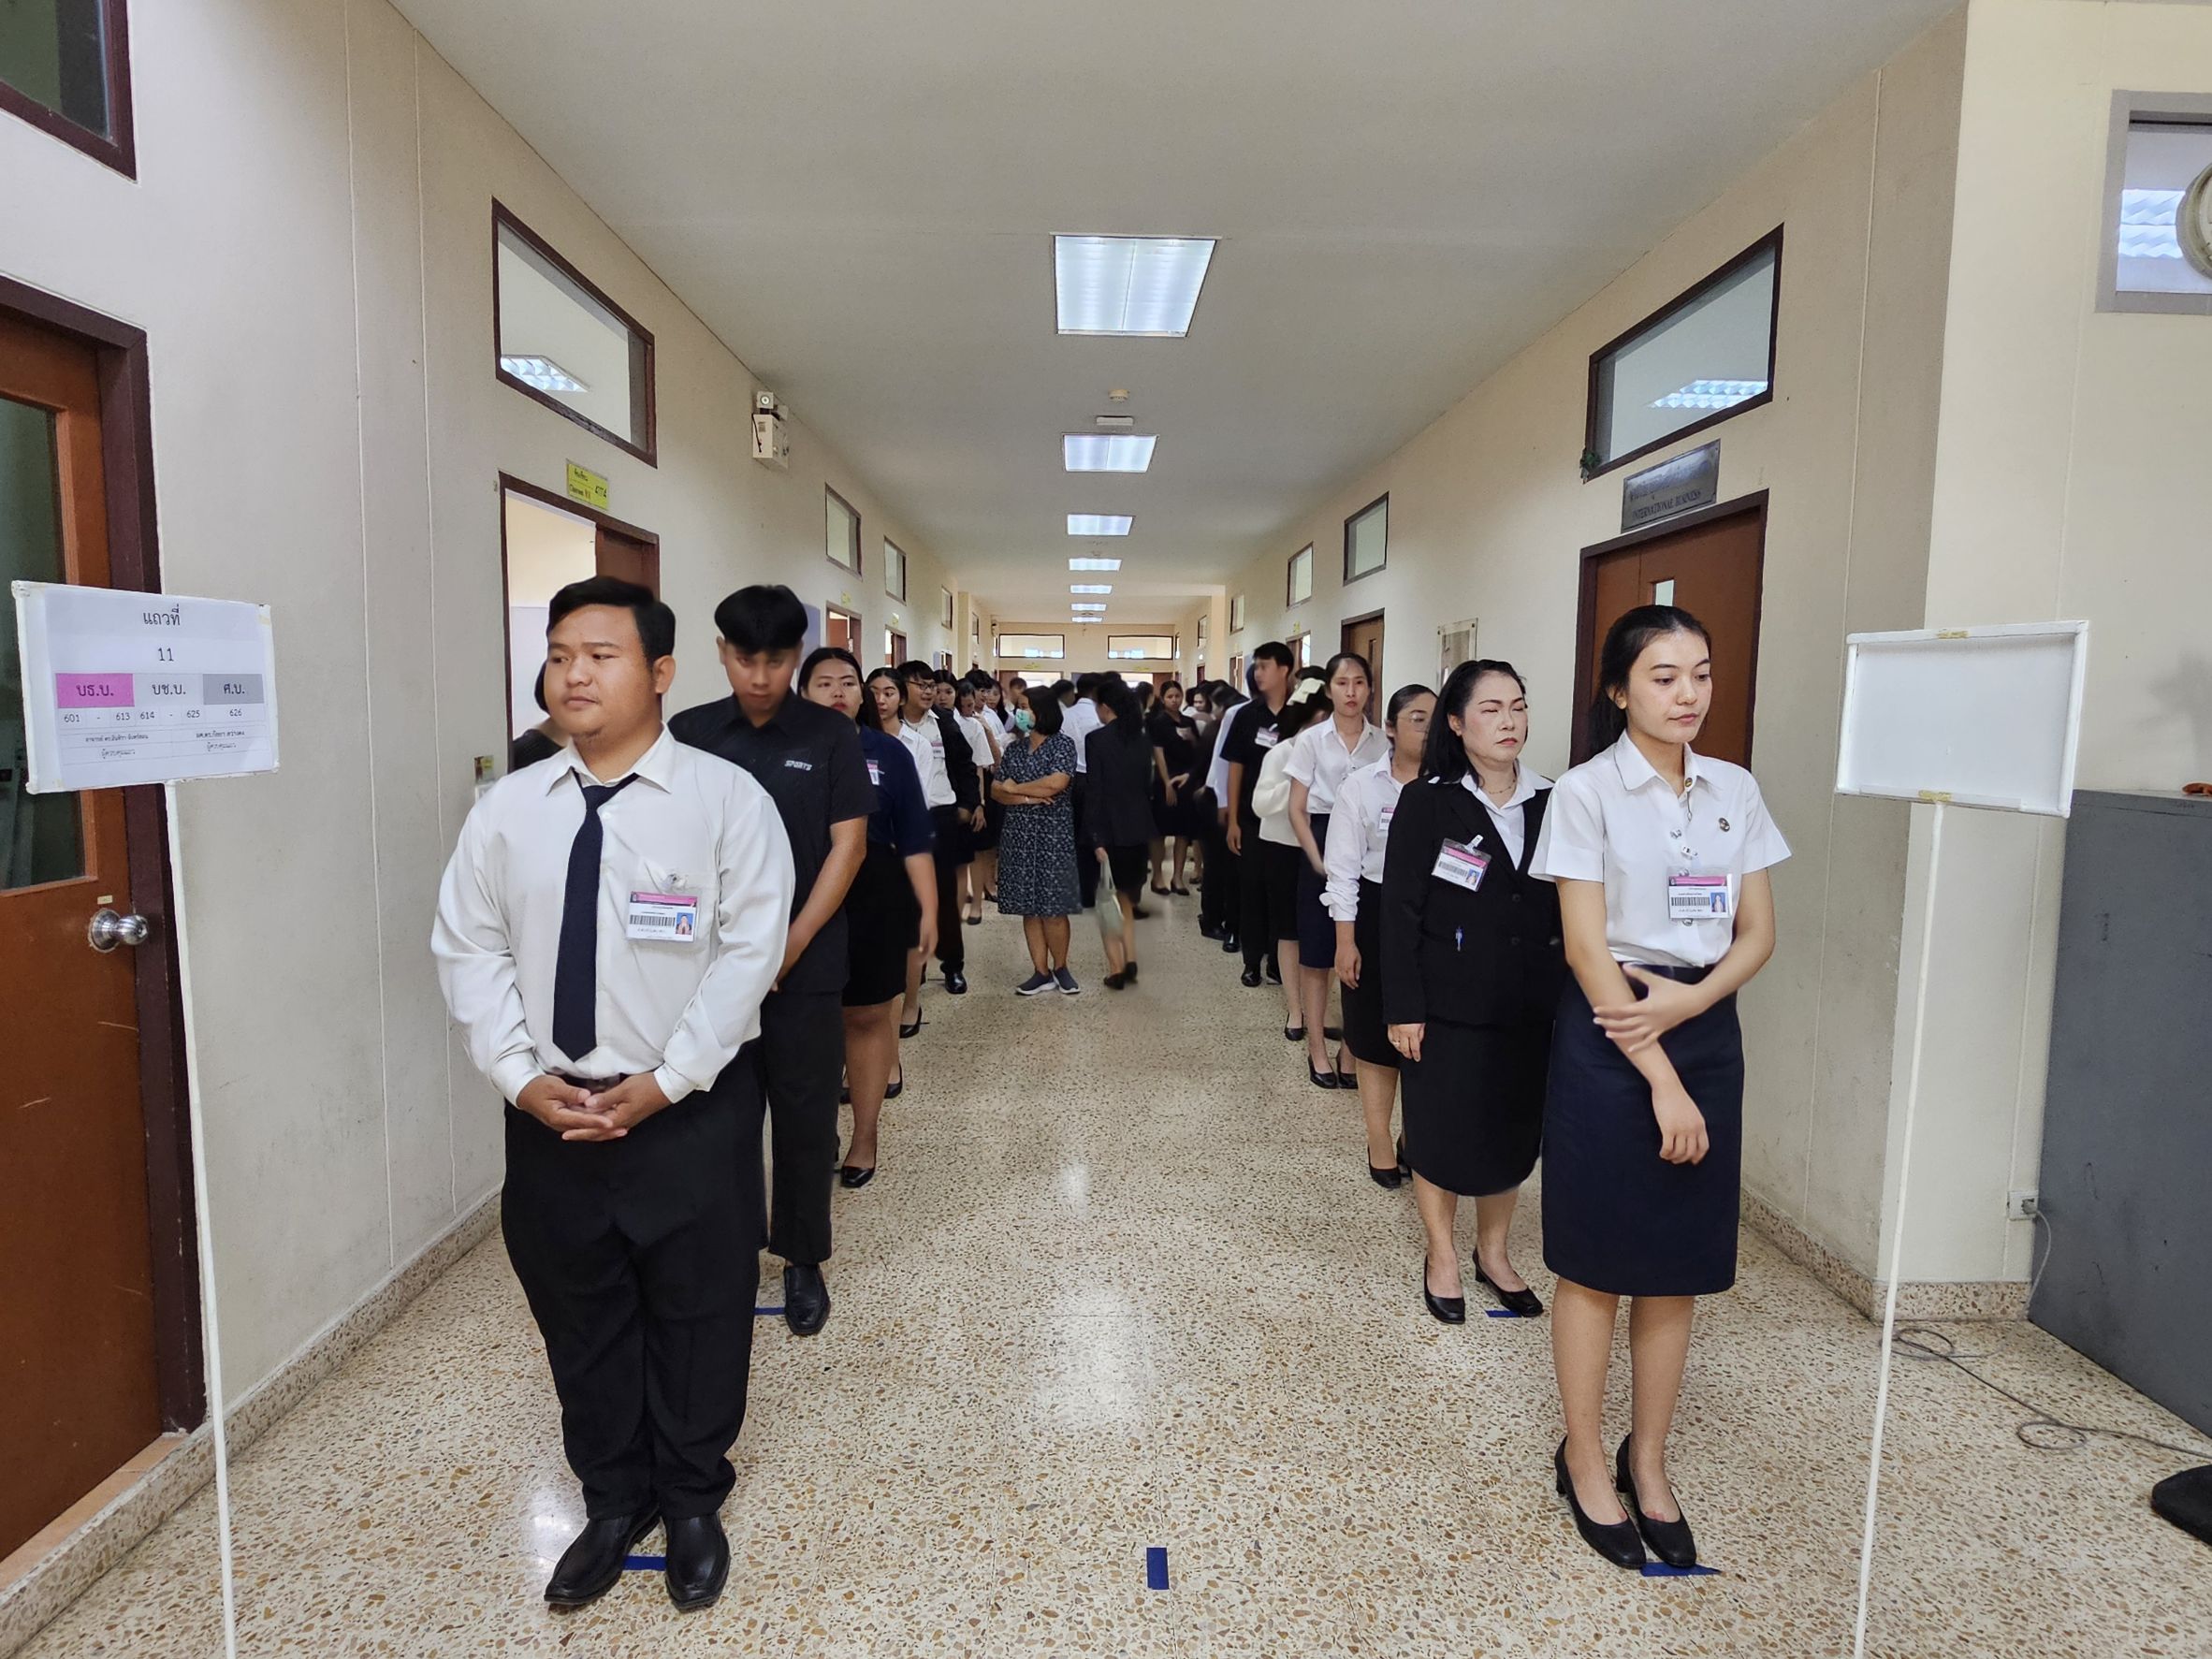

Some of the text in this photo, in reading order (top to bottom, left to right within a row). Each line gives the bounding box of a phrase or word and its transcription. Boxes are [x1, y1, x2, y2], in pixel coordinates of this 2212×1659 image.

[142, 604, 181, 626] แถวที่
[157, 648, 175, 662] 11
[76, 683, 114, 697] บธ.บ.
[152, 683, 186, 696] บช.บ.
[64, 713, 80, 723] 601
[116, 711, 130, 721] 613
[140, 711, 155, 720] 614
[186, 709, 200, 719] 625
[229, 707, 242, 717] 626
[784, 760, 813, 771] SPORTS
